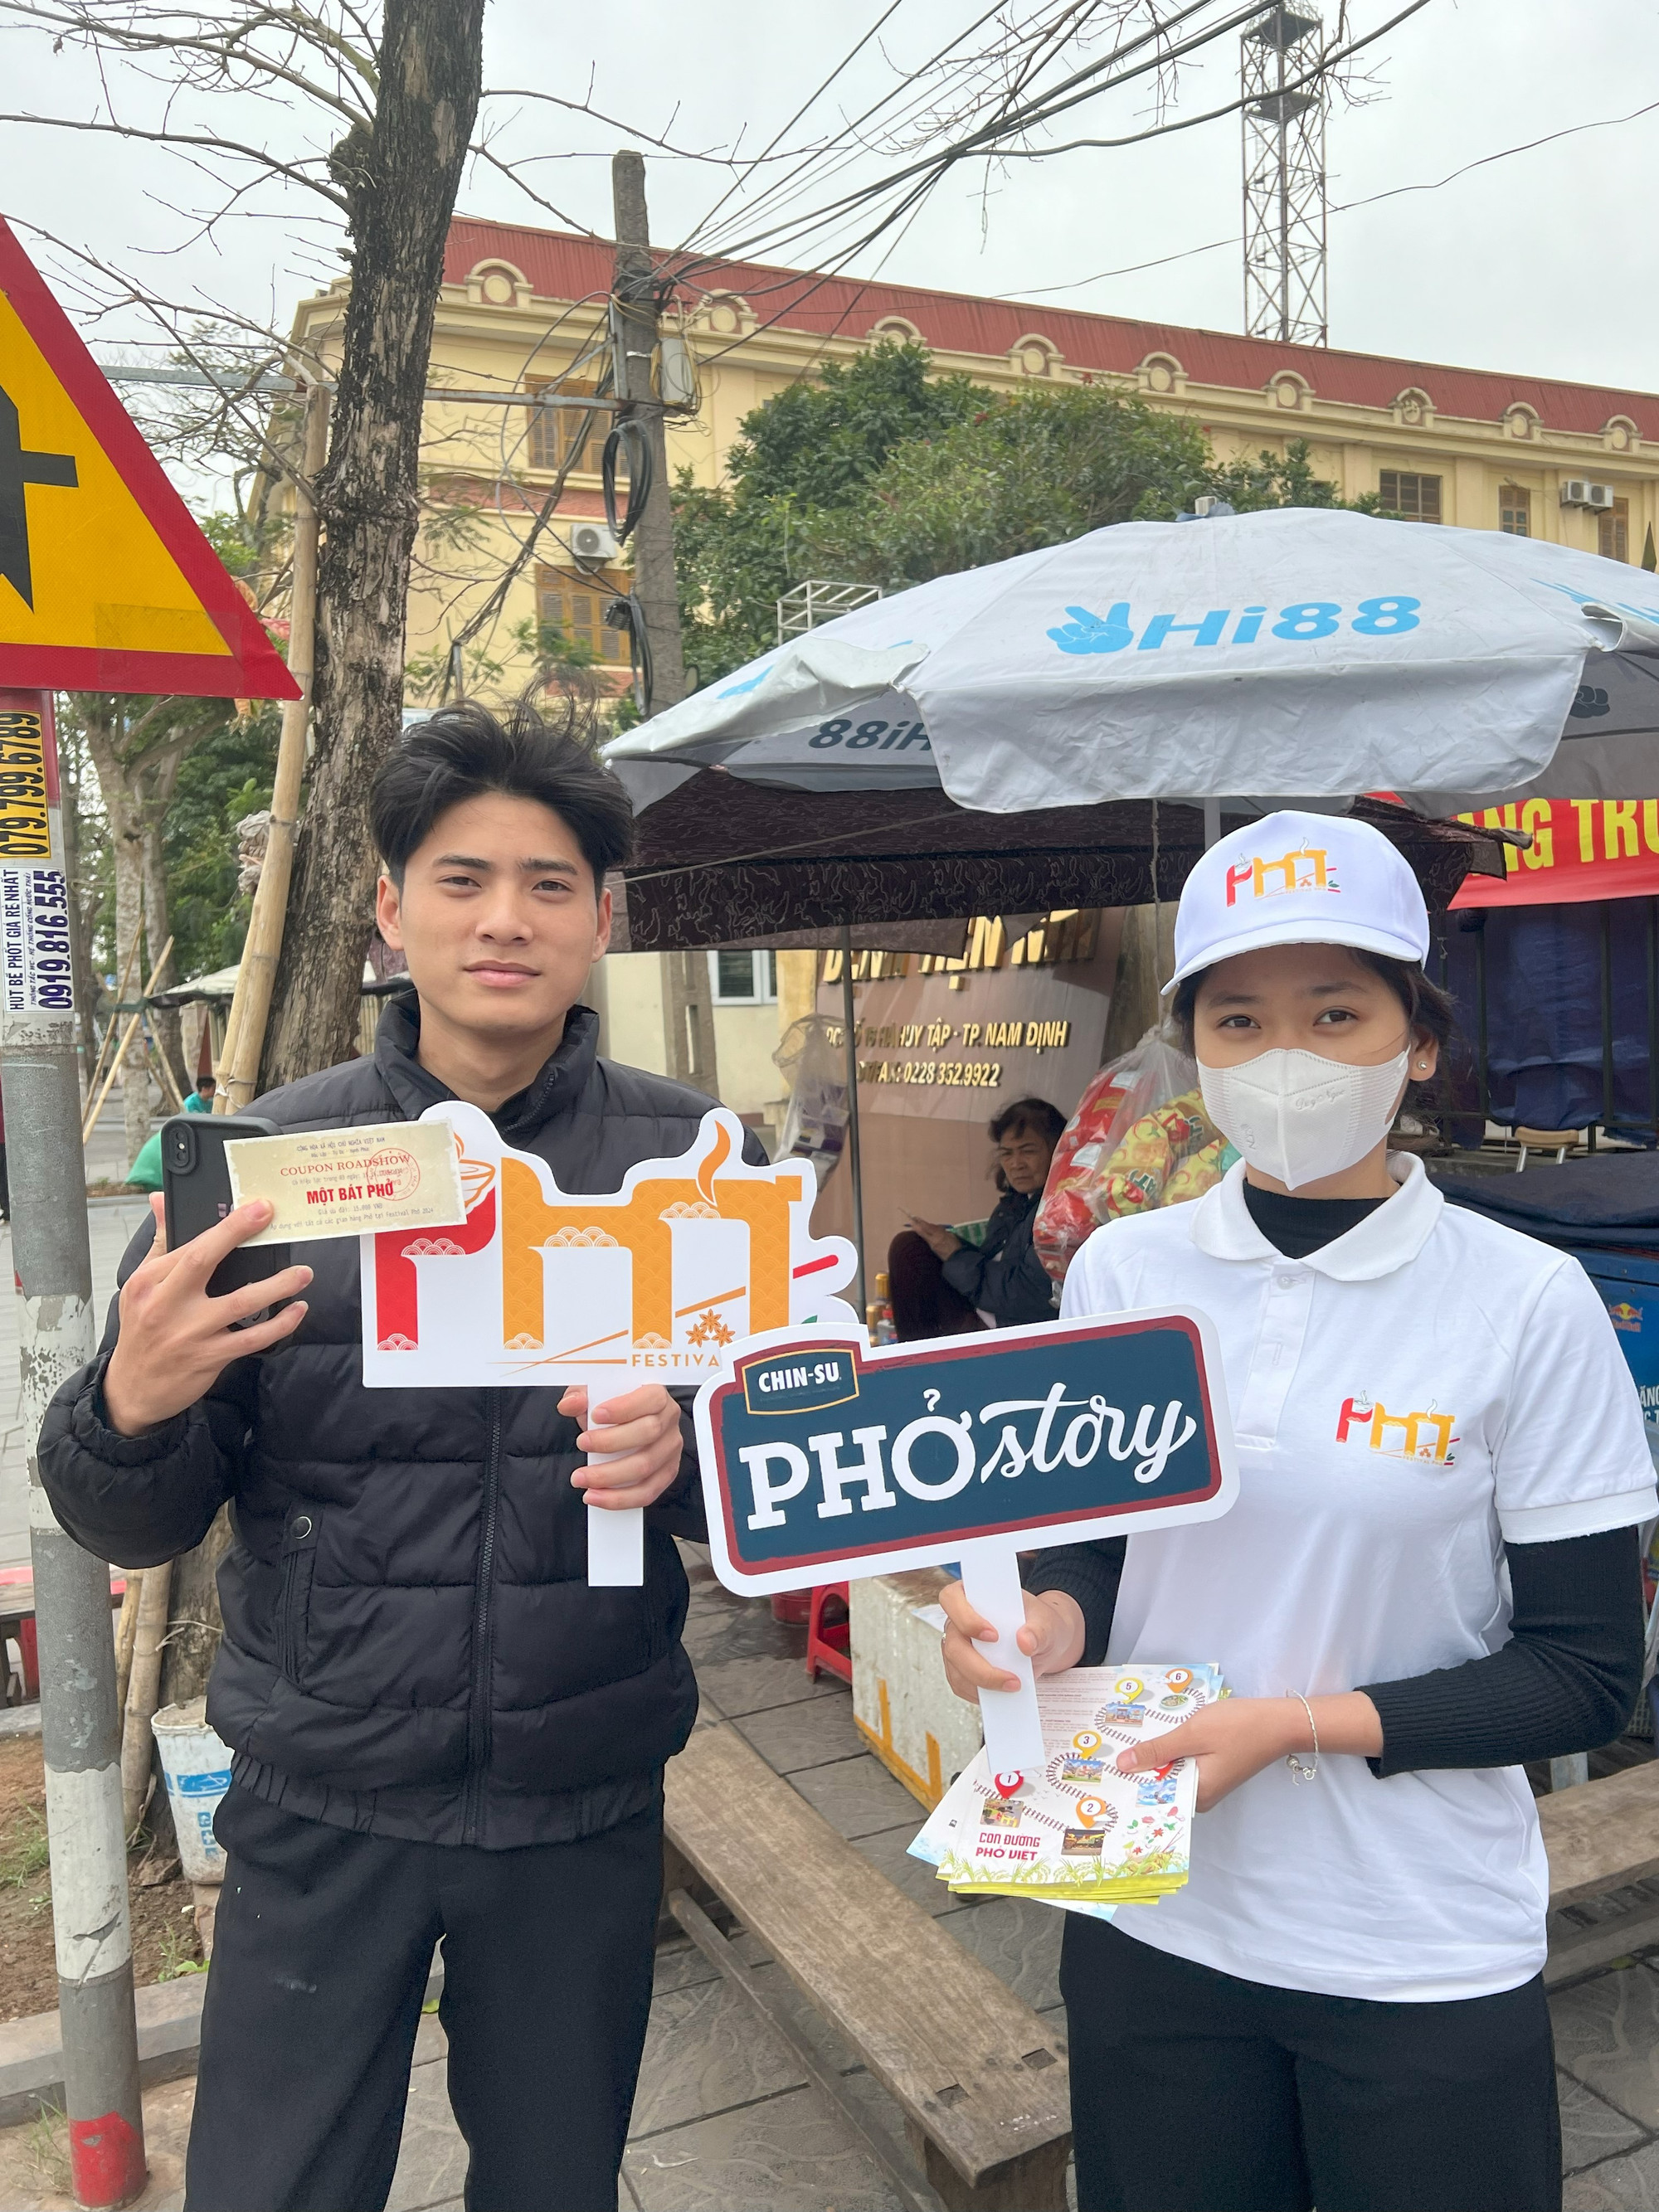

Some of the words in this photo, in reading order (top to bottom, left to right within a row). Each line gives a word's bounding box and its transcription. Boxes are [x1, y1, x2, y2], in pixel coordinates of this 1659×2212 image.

[1137, 596, 1421, 650] Hi88
[0, 712, 49, 855] 079.799.6789
[1, 869, 19, 902] NHẤT
[3, 921, 22, 938] GIÁ
[33, 870, 73, 1009] 0919.816.555
[4, 941, 22, 969] PHỐT
[7, 989, 24, 1010] HÚT
[900, 1023, 924, 1048] HUY
[927, 1016, 952, 1053] TẬP
[985, 1021, 1024, 1048] NAM
[1025, 1020, 1068, 1054] ĐỊNH
[903, 1061, 936, 1084] 0228
[937, 1062, 1001, 1087] 352.9922
[280, 1163, 333, 1177] COUPON
[337, 1154, 411, 1172] ROADSHOW
[306, 1186, 334, 1206] MỘT
[338, 1184, 363, 1201] BÁT
[367, 1178, 394, 1198] PHỞ
[632, 1354, 720, 1368] FESTIVA
[758, 1361, 839, 1393] CHIN-SU
[739, 1388, 977, 1531] PHỞ
[979, 1382, 1197, 1484] story
[1126, 1682, 1132, 1690] 5
[1175, 1672, 1181, 1681] 6
[1083, 1735, 1090, 1744] 3
[1006, 1775, 1012, 1783] 1
[1087, 1804, 1094, 1813] 2
[979, 1832, 1001, 1845] CON
